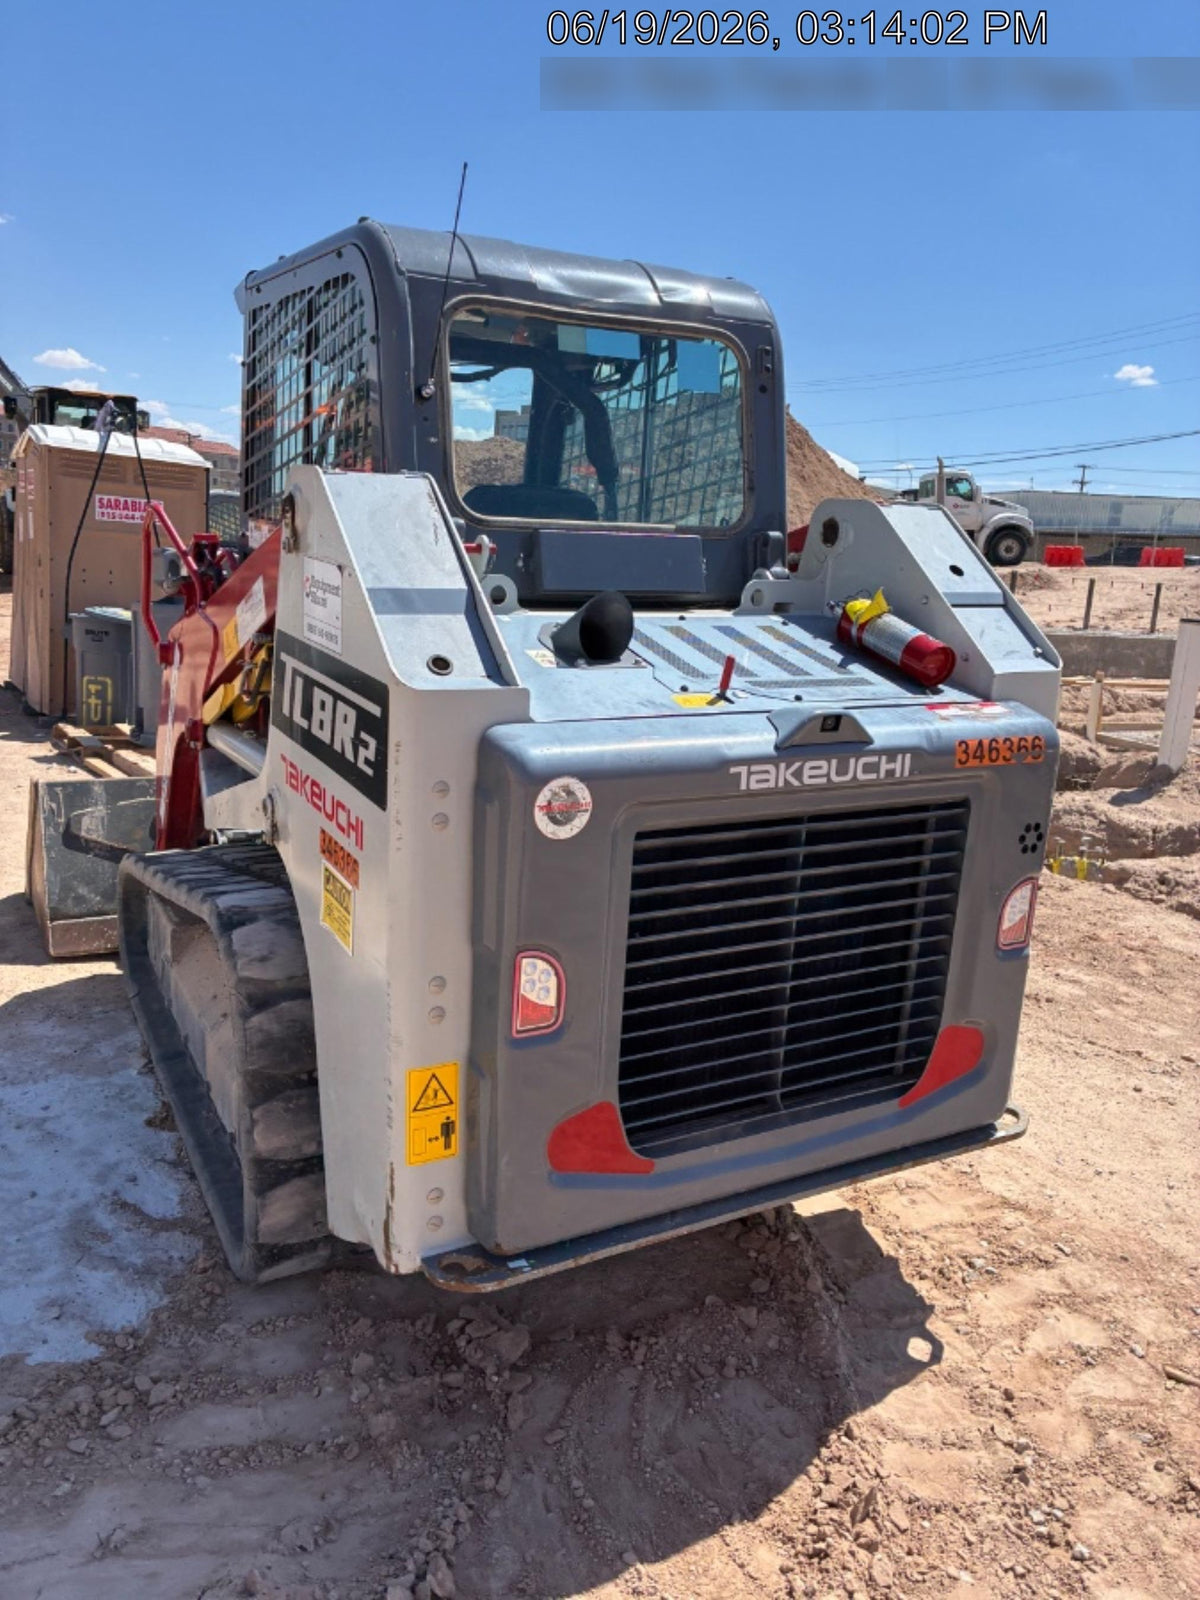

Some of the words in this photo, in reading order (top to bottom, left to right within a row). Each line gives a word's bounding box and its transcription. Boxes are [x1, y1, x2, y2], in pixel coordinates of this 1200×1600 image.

[280, 651, 383, 777] TL8R2
[729, 752, 912, 791] TAKEUCHI
[956, 735, 1044, 766] 346366
[280, 752, 364, 851] TAKEUCHI
